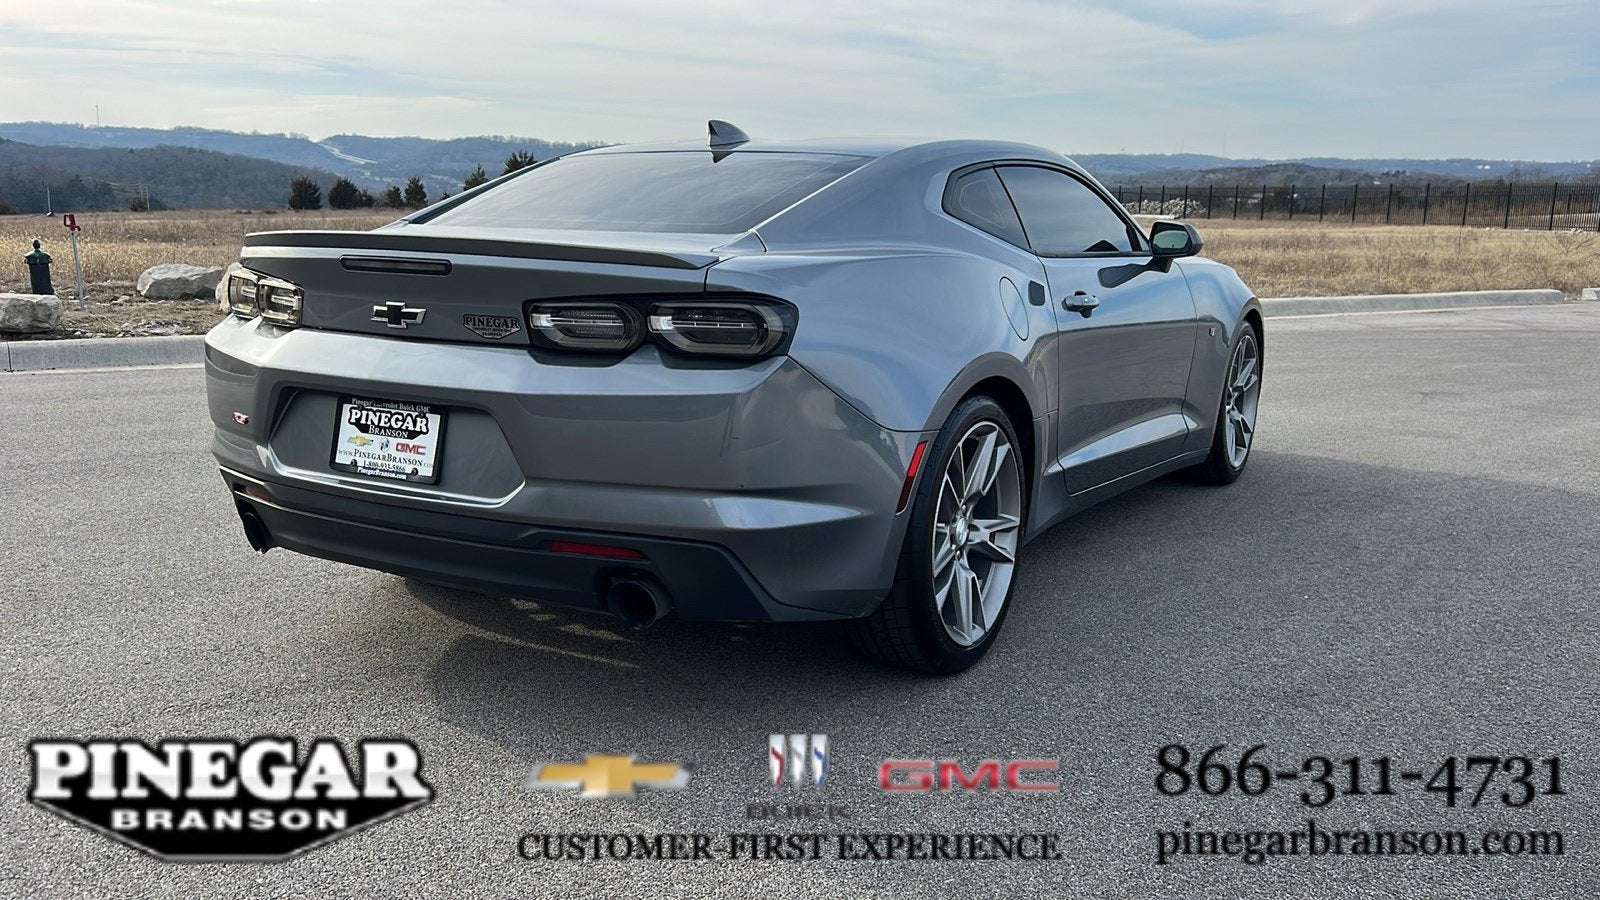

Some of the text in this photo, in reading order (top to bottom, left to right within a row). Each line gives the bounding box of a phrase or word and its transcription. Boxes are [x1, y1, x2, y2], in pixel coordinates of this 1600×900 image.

[465, 316, 519, 329] PINEGAR
[352, 398, 372, 407] Pinegar
[399, 403, 415, 411] Buick
[416, 405, 431, 413] GMC
[350, 408, 428, 432] PINEGAR
[368, 424, 409, 438] BRANSON
[395, 442, 427, 455] GMC
